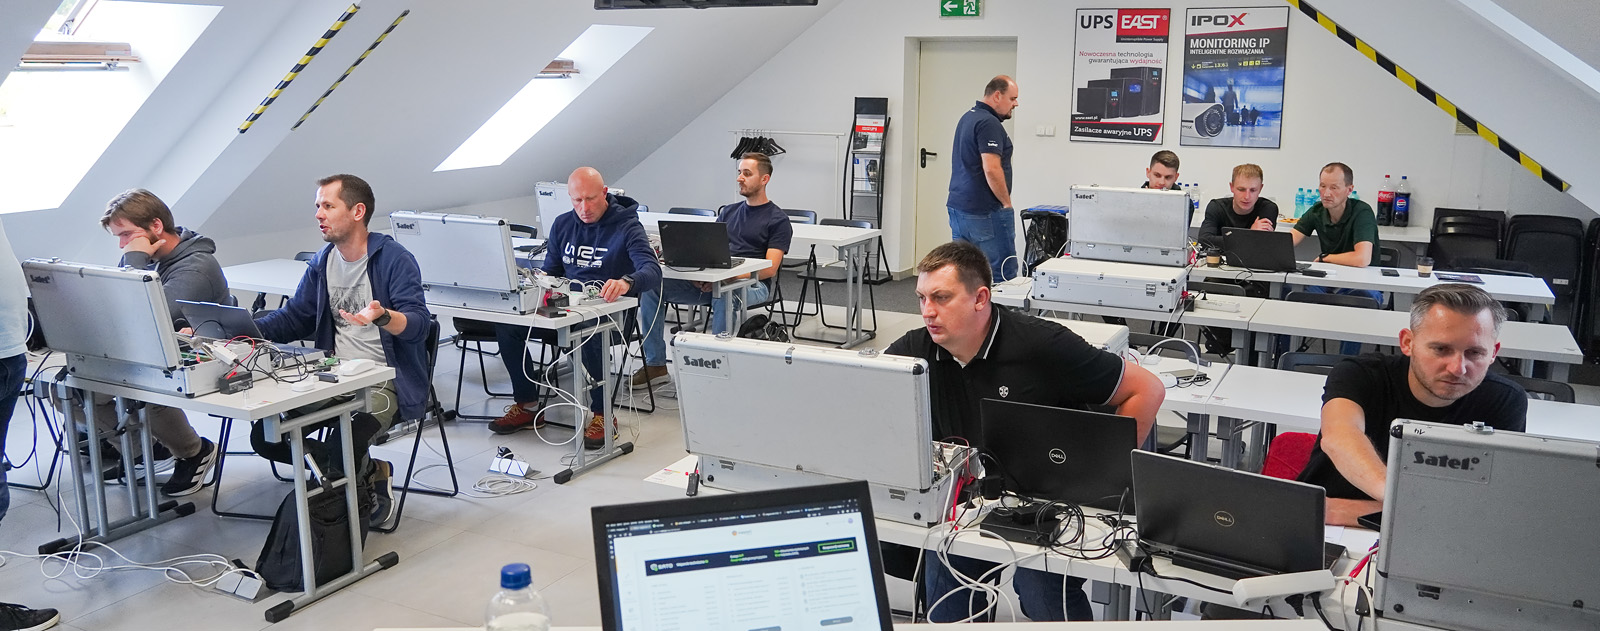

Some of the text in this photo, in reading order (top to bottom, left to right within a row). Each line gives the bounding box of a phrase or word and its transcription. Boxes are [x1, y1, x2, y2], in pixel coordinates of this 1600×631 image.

[1080, 15, 1113, 29] UPS
[1191, 12, 1248, 28] IPOX
[1190, 38, 1270, 48] MONITORING IP
[1074, 126, 1153, 137] Zasilacze awaryjne UPS
